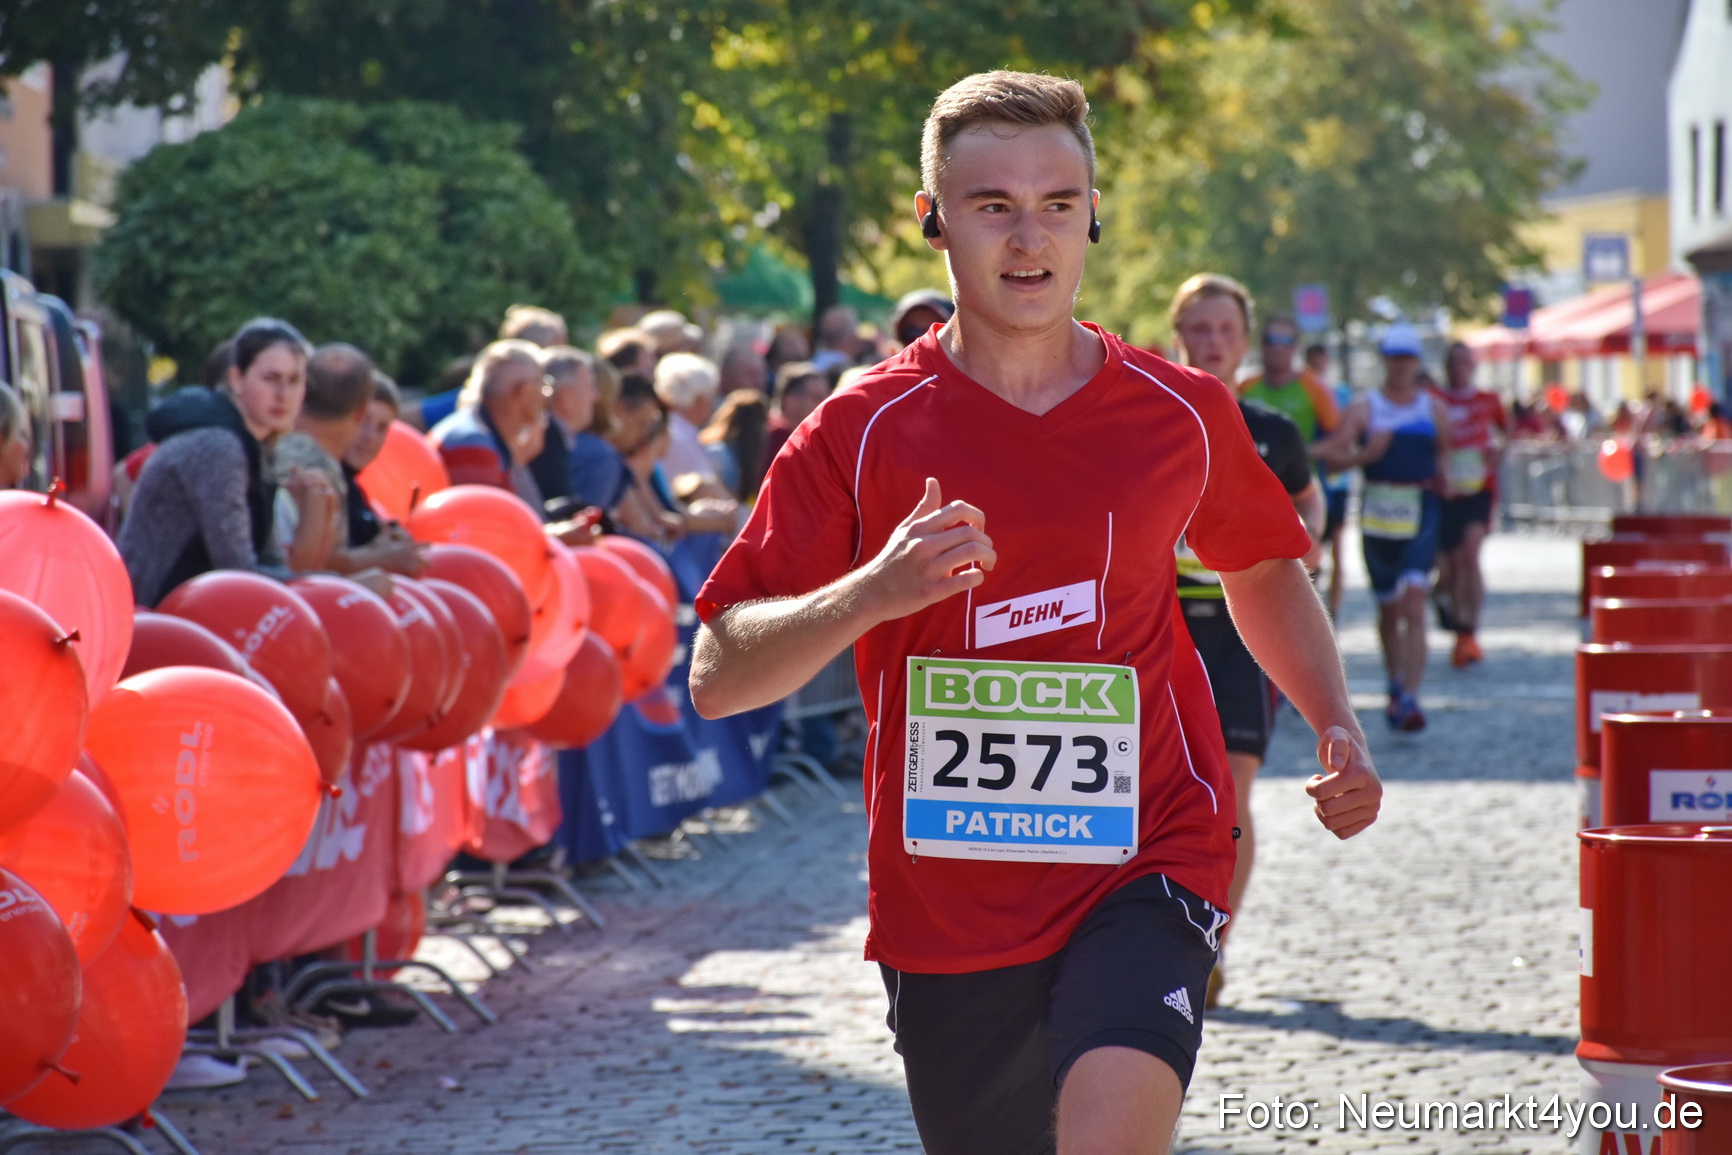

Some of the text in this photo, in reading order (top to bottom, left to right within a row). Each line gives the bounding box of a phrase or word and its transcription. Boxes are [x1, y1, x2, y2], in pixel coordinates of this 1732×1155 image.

[1008, 600, 1064, 629] DEHN
[925, 667, 1119, 716] BOCK
[1118, 741, 1128, 752] C
[933, 729, 1109, 794] 2573
[946, 810, 1093, 839] PATRICK
[1163, 996, 1194, 1025] adidas
